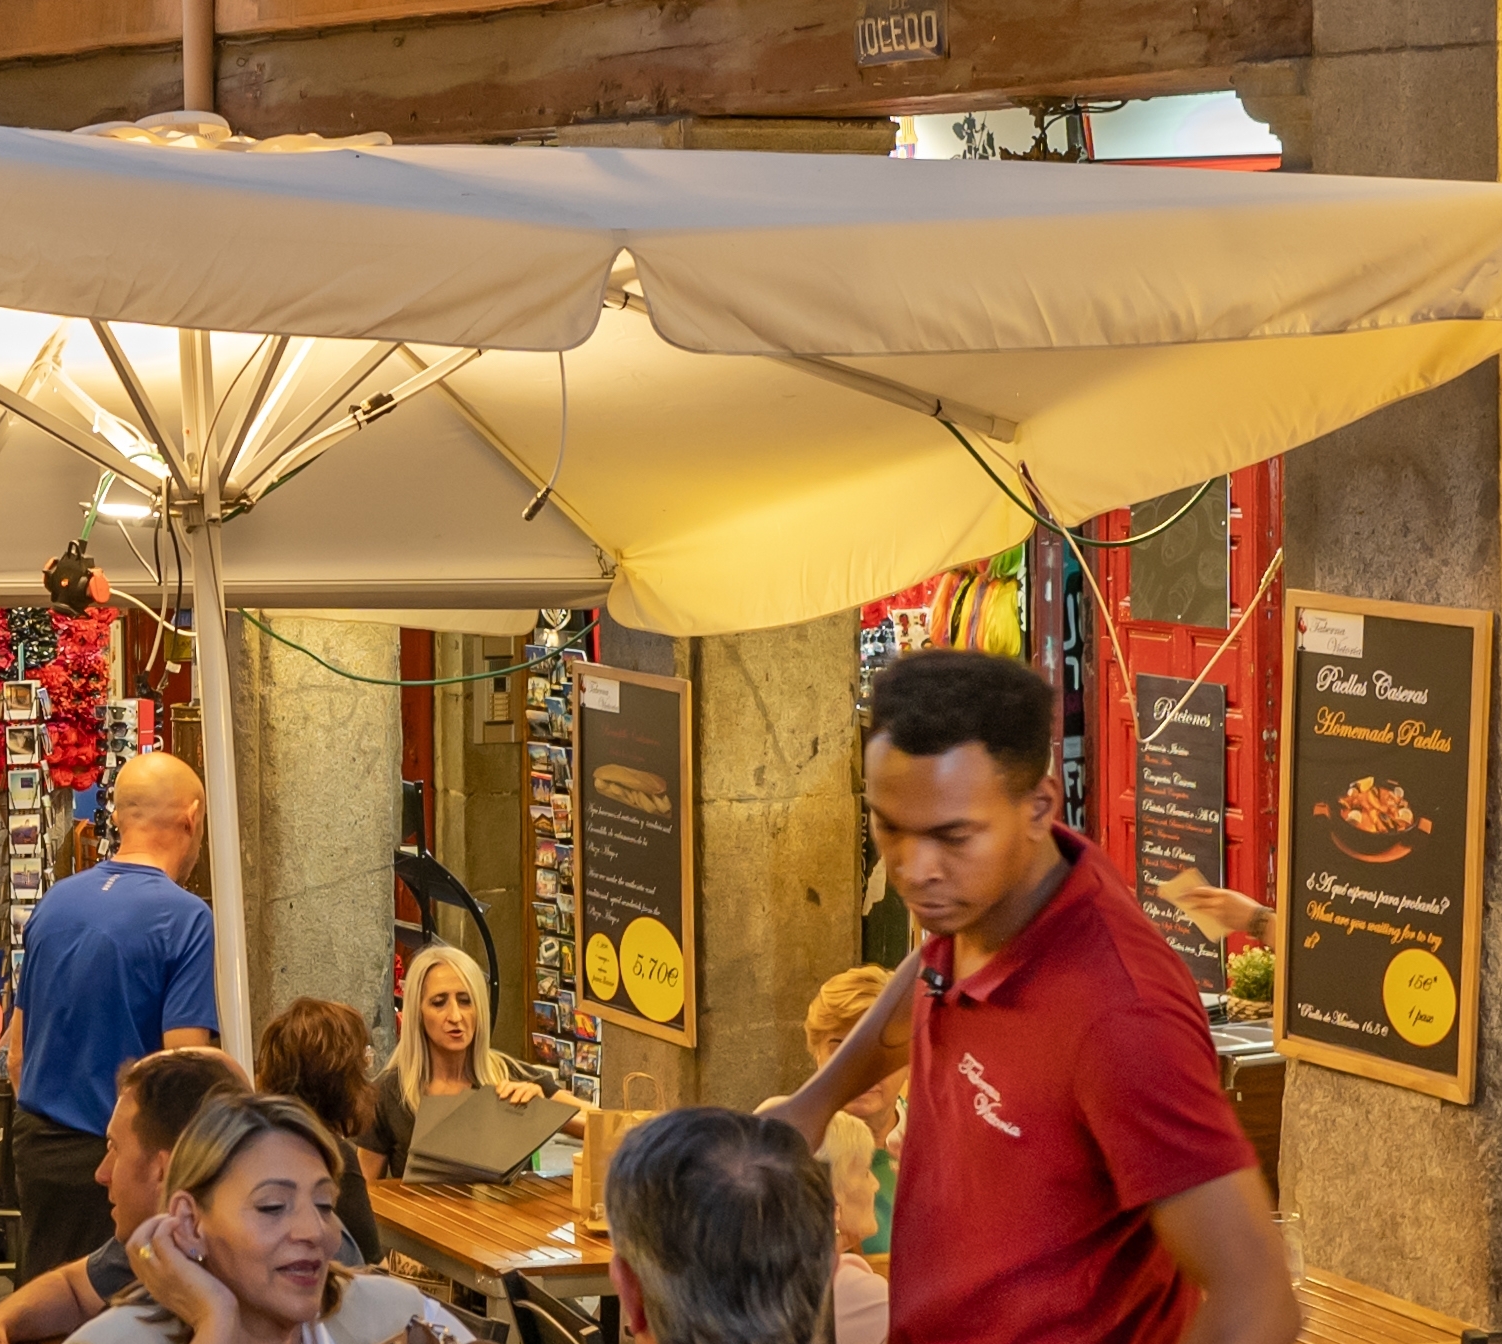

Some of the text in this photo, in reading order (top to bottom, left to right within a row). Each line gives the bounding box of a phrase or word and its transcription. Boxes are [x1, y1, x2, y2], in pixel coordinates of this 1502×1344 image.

[856, 10, 937, 56] TOLEDO
[1316, 665, 1429, 705] Paellas Caseras
[1314, 706, 1452, 753] Homemade Paellas
[632, 953, 679, 988] 5,70€
